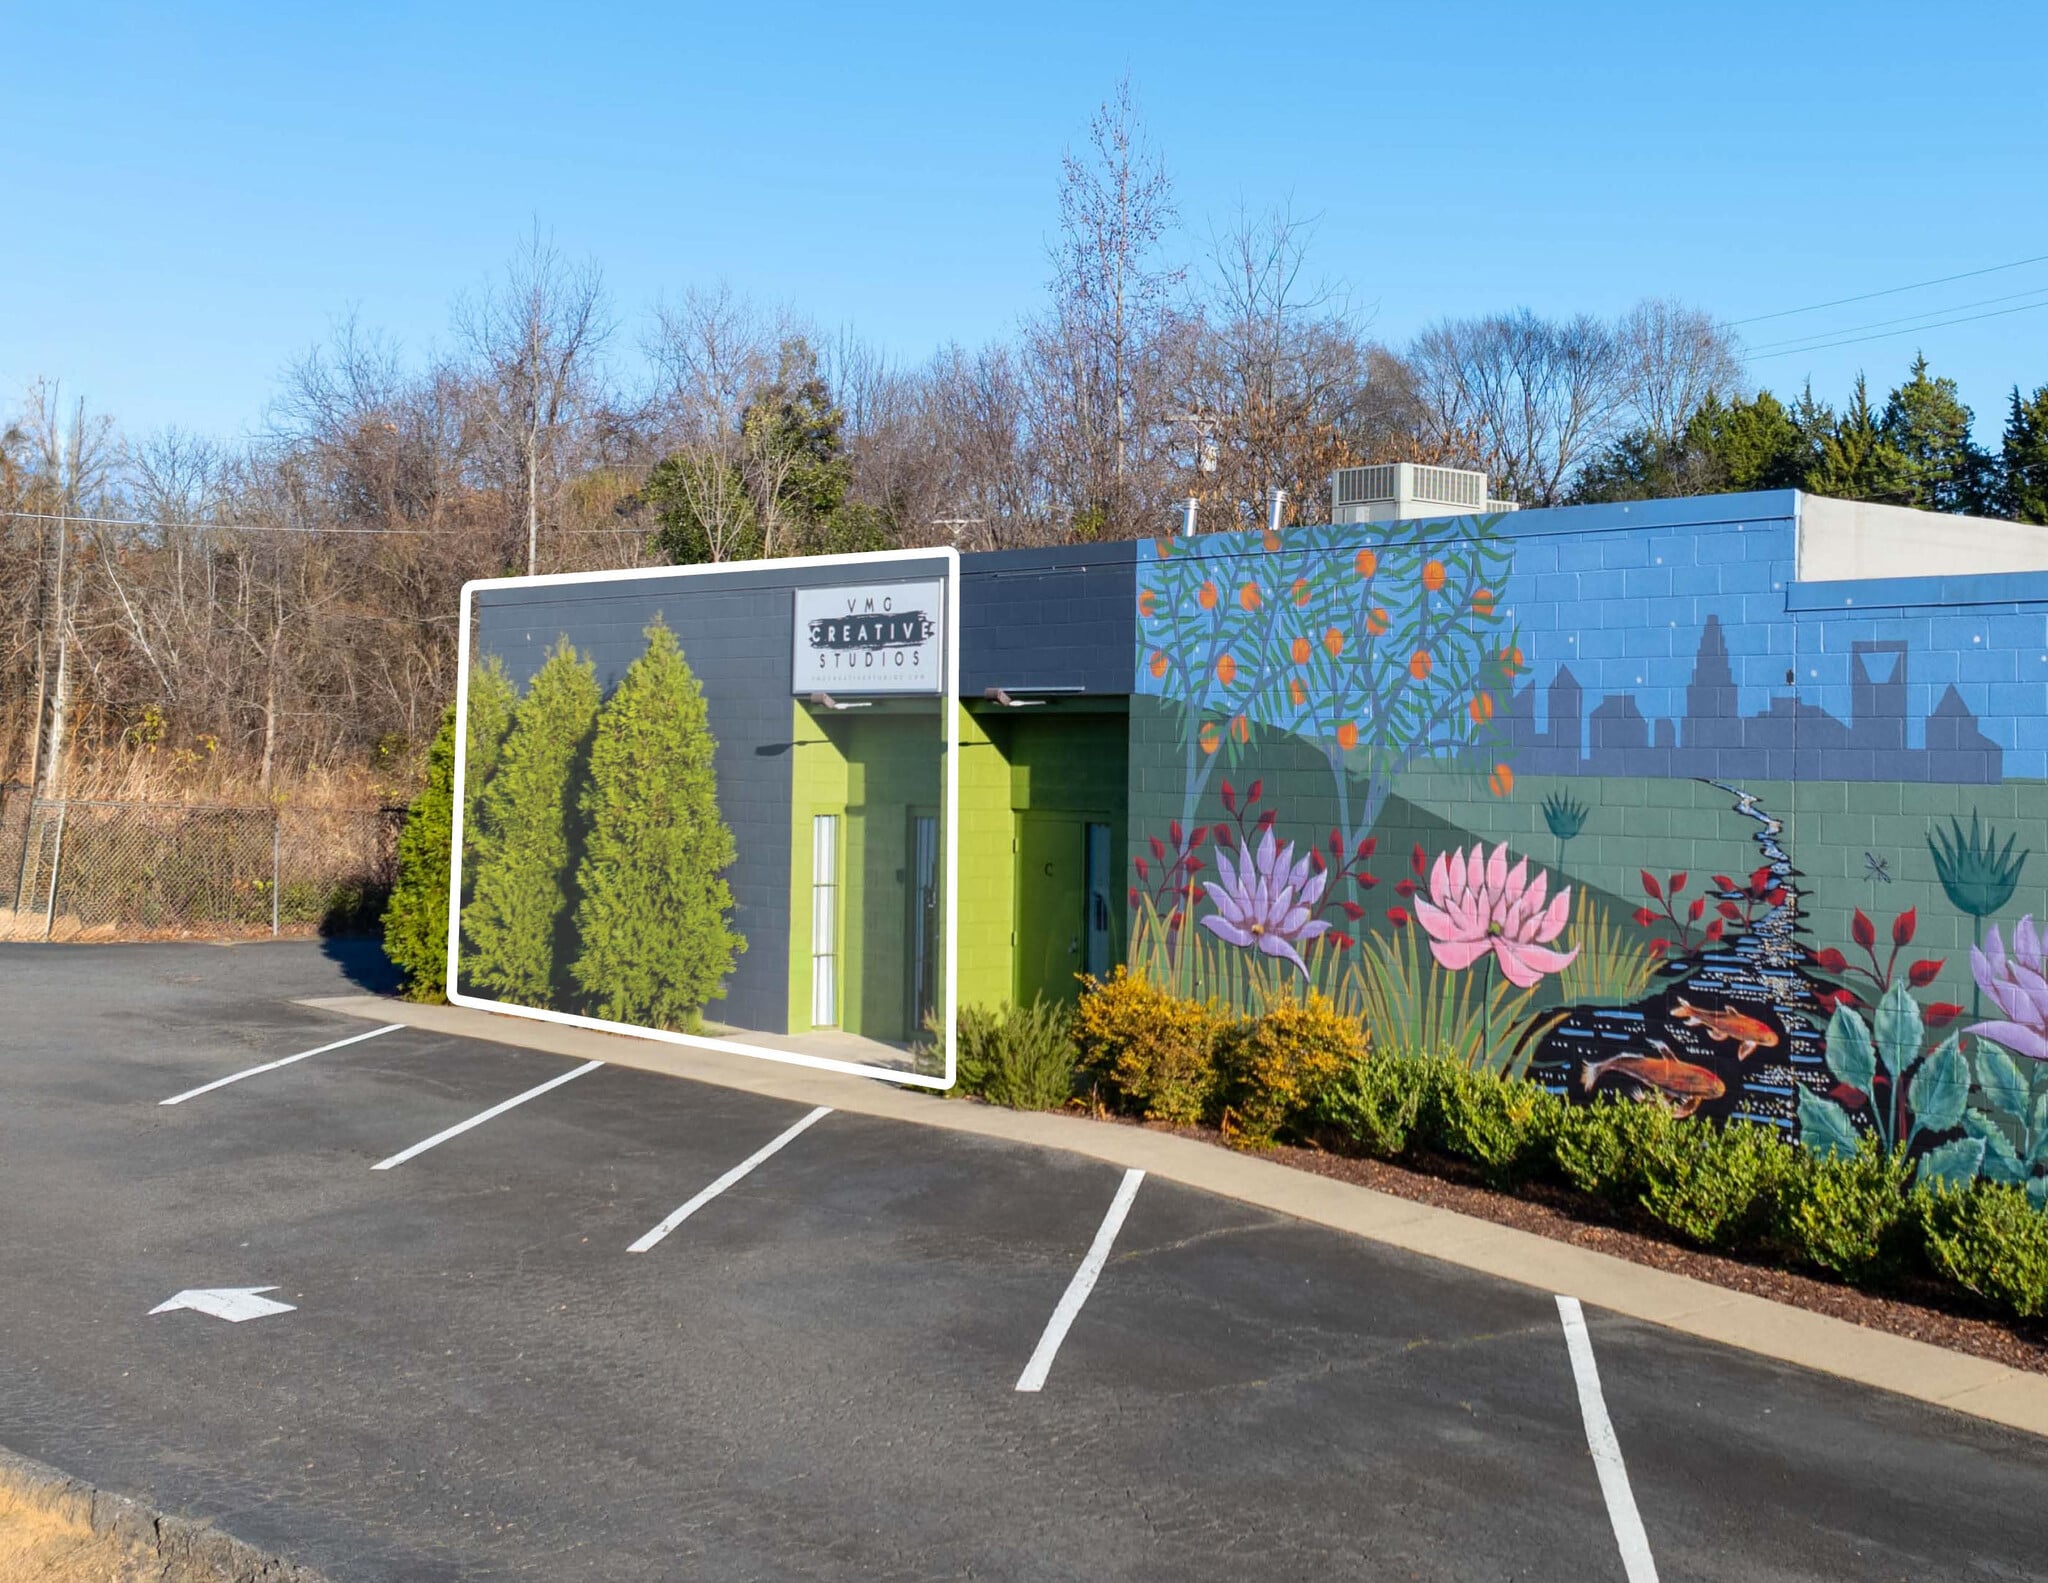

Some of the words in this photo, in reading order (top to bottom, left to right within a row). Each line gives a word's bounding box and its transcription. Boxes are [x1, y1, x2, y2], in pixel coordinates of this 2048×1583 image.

[847, 596, 893, 613] VMG
[811, 621, 930, 643] CREATIVE
[819, 650, 920, 669] STUDIOS
